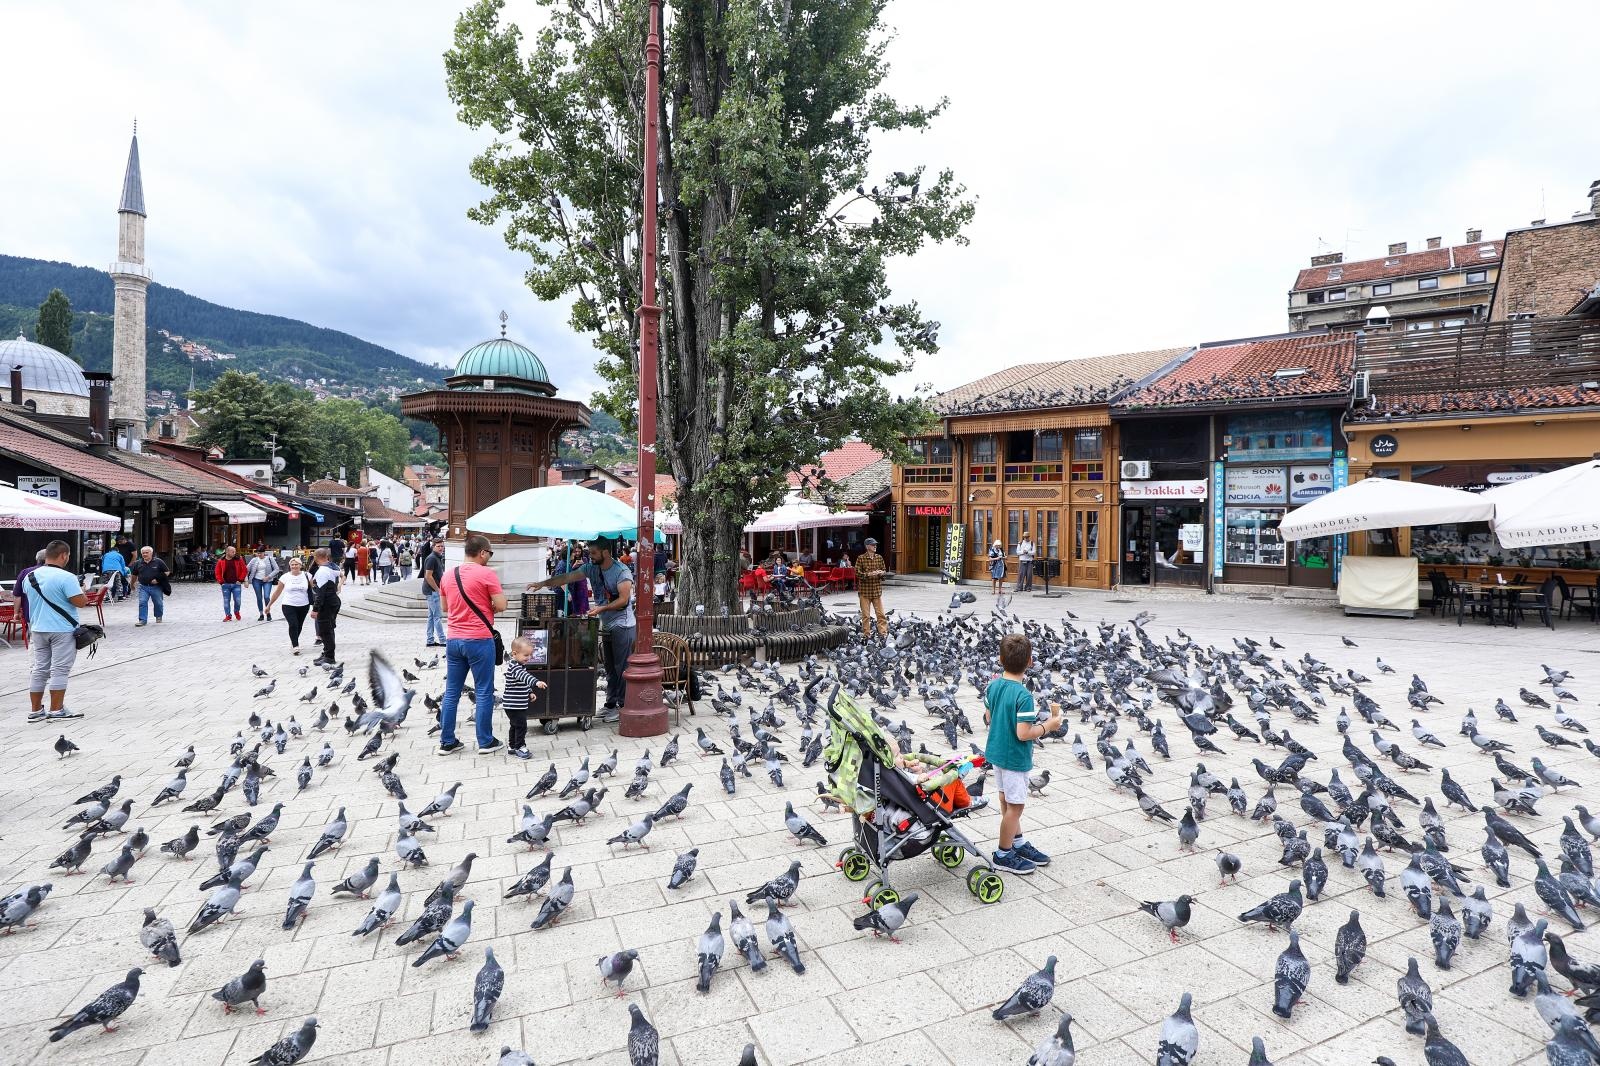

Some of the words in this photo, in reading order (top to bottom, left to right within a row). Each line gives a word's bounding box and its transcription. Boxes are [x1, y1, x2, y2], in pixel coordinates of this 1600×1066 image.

[1374, 440, 1394, 448] حلال
[1144, 486, 1184, 495] bakkal
[1312, 516, 1368, 529] ADDRESS
